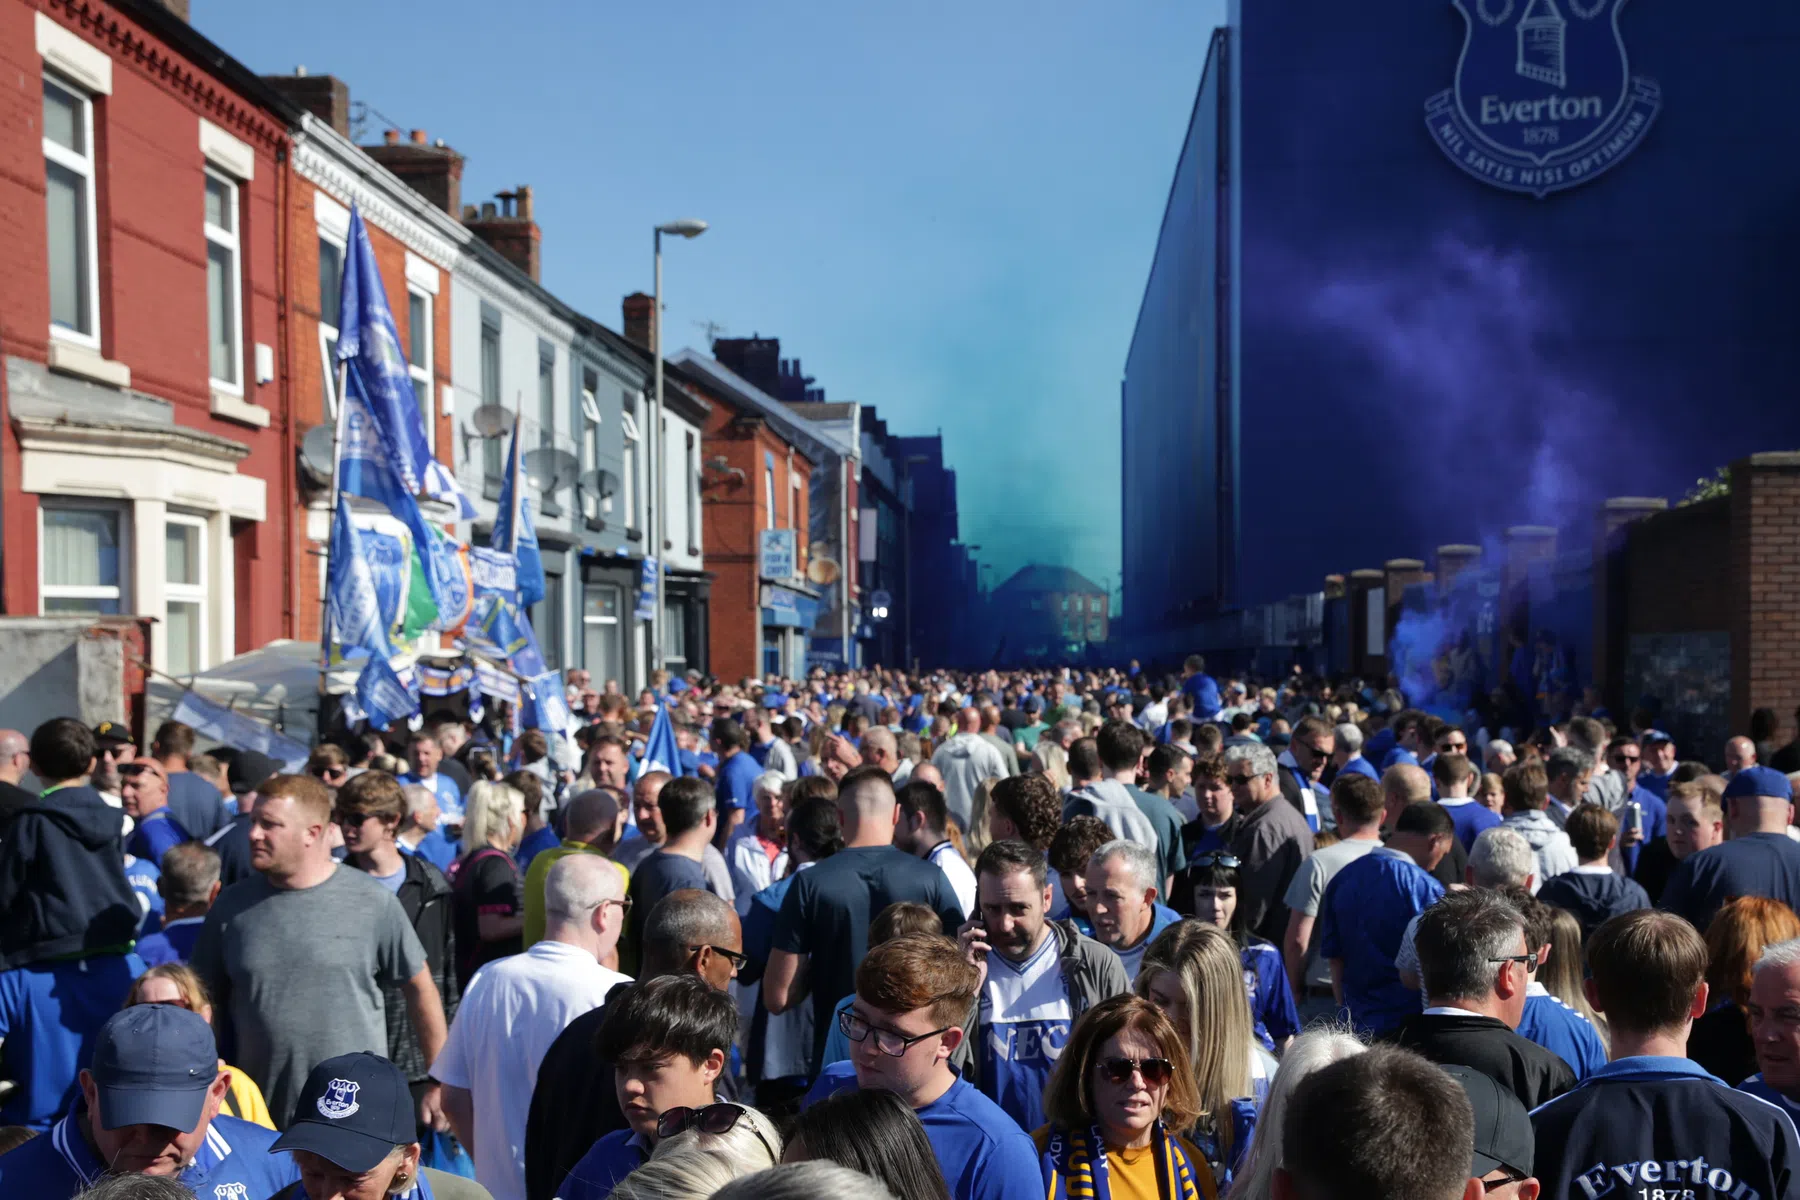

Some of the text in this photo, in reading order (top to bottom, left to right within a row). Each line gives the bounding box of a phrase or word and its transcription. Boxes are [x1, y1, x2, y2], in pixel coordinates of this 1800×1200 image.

[1480, 94, 1602, 125] Everton
[1523, 126, 1560, 146] 1878
[1439, 121, 1465, 155] NIL
[1464, 149, 1514, 182] SATIS
[1519, 166, 1563, 185] NISI
[987, 1024, 1069, 1062] NEC
[325, 1098, 350, 1109] Everton
[1050, 1133, 1062, 1166] ADY
[1573, 1156, 1760, 1200] Everton
